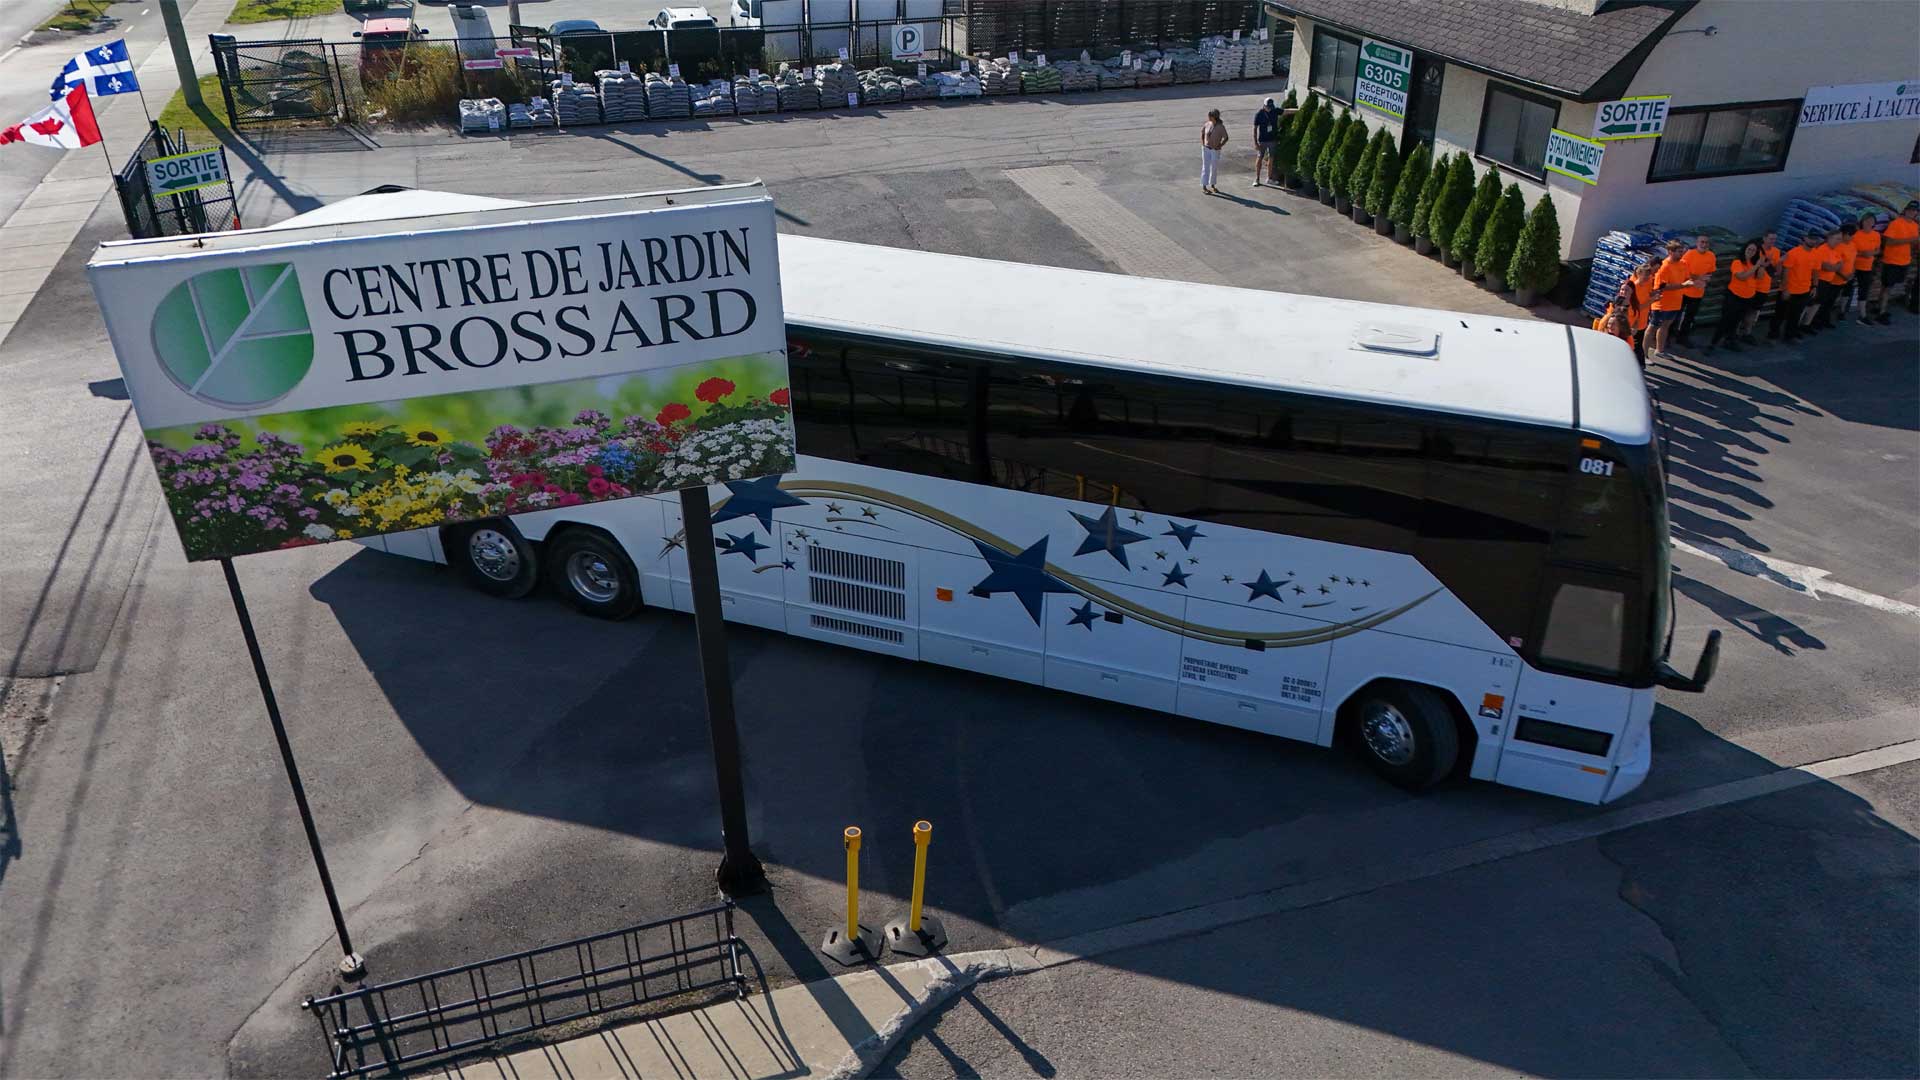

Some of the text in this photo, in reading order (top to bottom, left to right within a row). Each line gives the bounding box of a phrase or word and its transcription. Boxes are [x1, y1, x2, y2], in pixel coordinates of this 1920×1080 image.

[902, 30, 916, 50] P
[1364, 63, 1403, 88] 6305
[1360, 80, 1404, 103] RÉCEPTION
[1358, 92, 1404, 115] EXPÉDITION
[1600, 101, 1666, 123] SORTIE
[1801, 102, 1861, 123] SERVICE
[1548, 134, 1604, 168] STATIONNEMENT
[153, 153, 219, 181] SORTIE
[323, 226, 752, 321] CENTRE DE JARDIN
[334, 287, 757, 383] BROSSARD
[1580, 457, 1614, 476] 081
